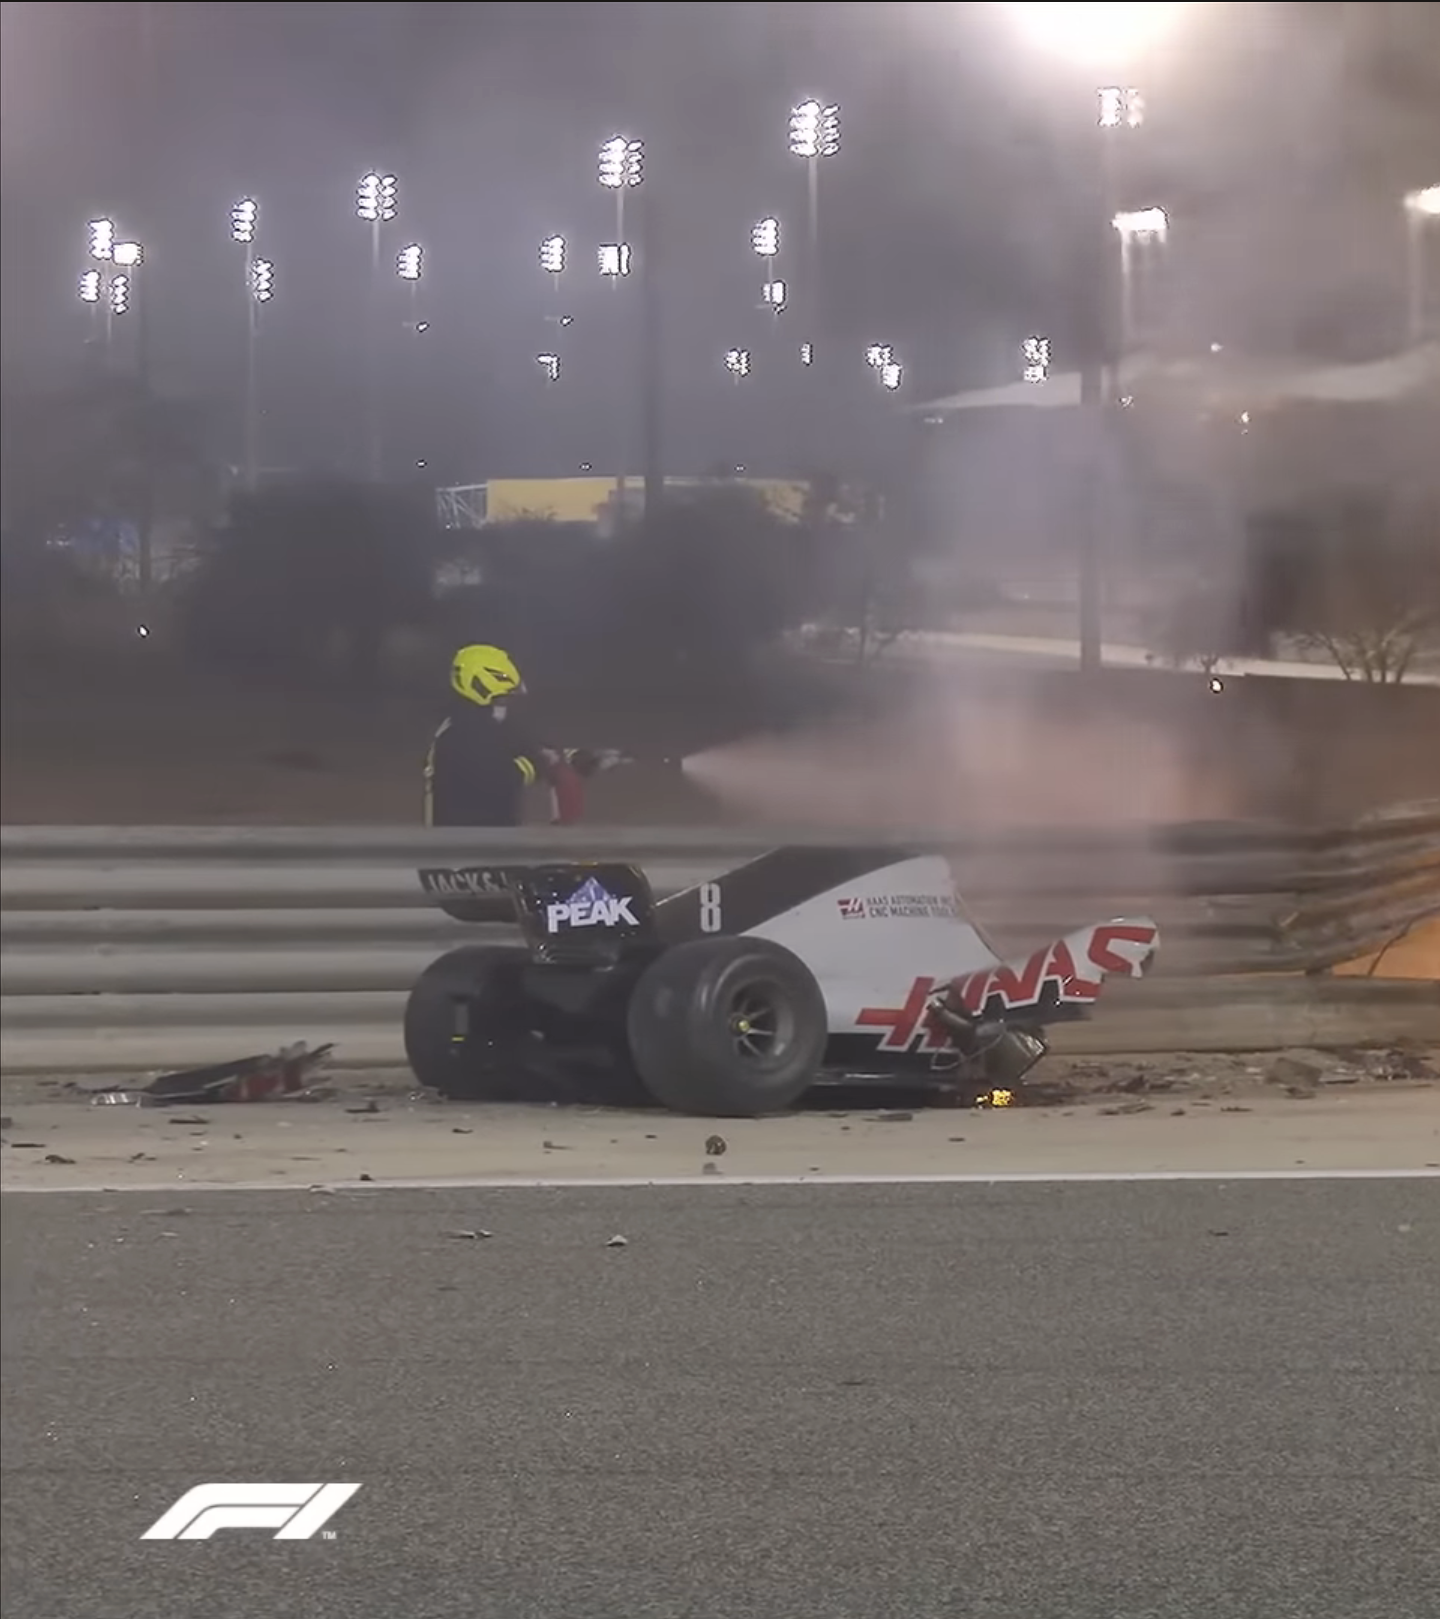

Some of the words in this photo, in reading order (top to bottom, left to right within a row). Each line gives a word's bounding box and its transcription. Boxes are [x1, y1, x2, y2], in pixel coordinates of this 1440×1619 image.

[547, 897, 640, 933] PEAK
[700, 883, 722, 932] 8
[869, 906, 889, 917] CNC
[890, 906, 930, 917] MACHINE
[855, 926, 1157, 1051] HAAS
